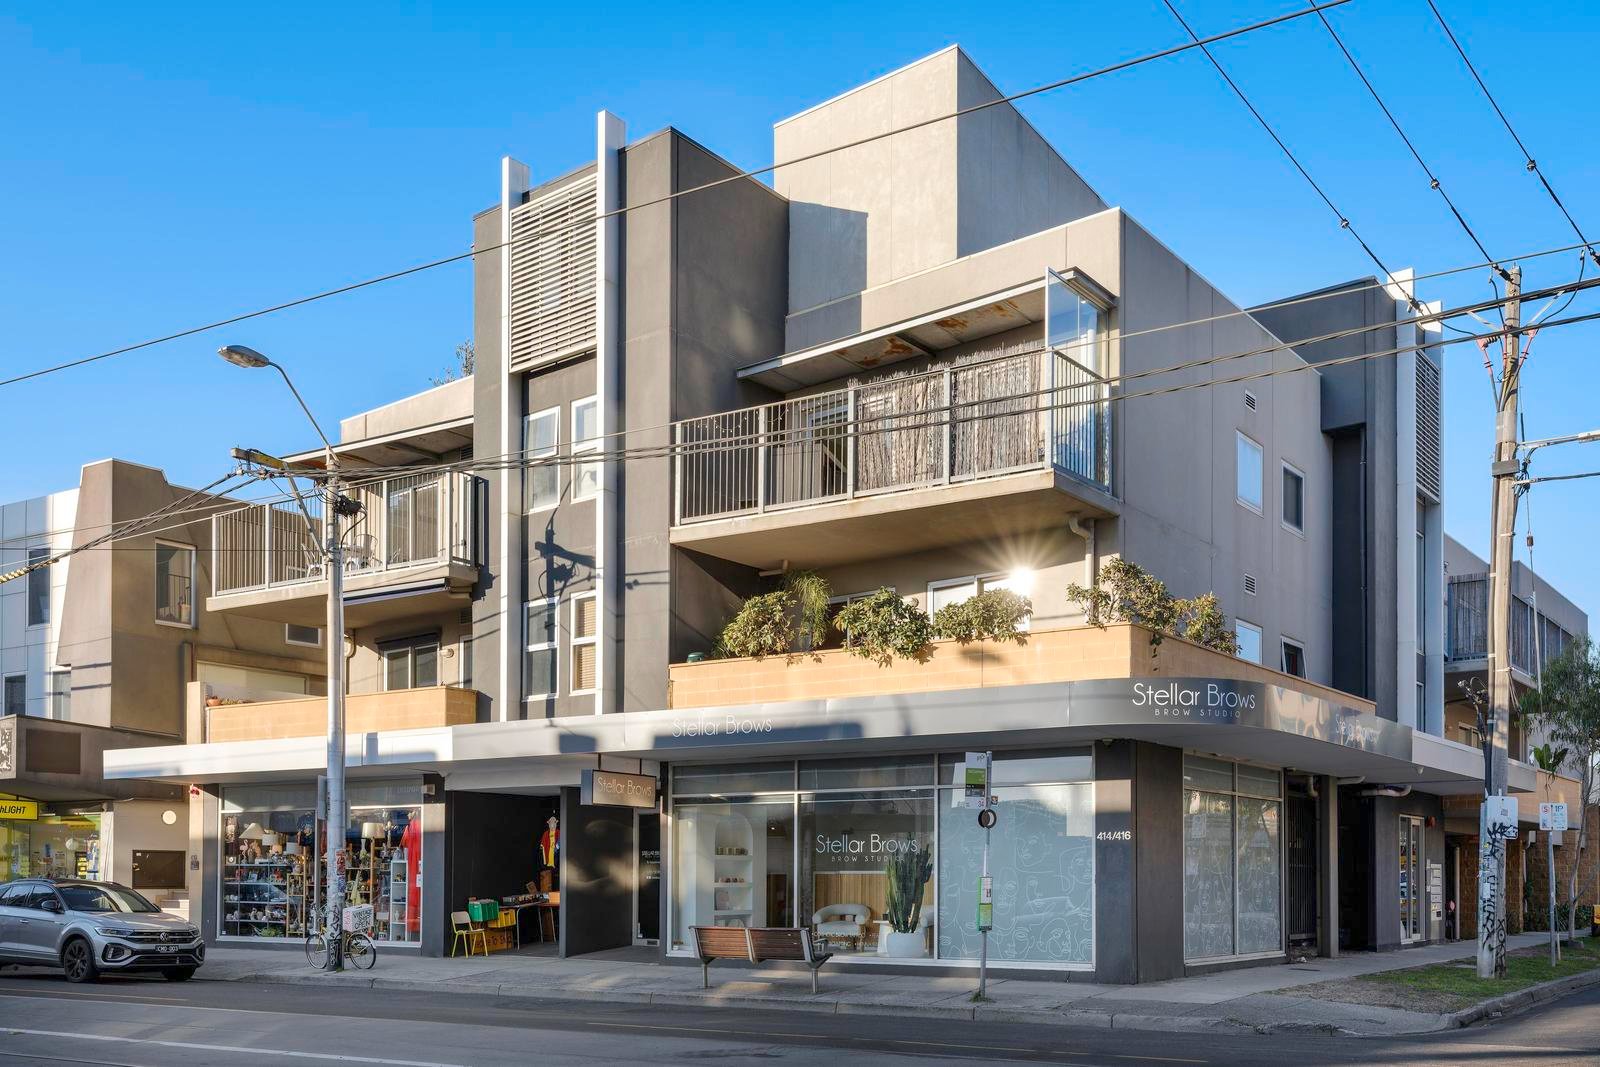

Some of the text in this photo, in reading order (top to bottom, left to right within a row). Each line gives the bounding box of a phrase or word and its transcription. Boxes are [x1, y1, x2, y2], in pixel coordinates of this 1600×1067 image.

[1132, 682, 1256, 709] Stellar Brows
[1154, 708, 1241, 718] BROW STUDIO
[671, 711, 773, 738] Stellar Brows
[597, 776, 652, 796] Stellar Brows
[815, 833, 918, 853] Stellar Brows
[1096, 831, 1131, 840] 414/416
